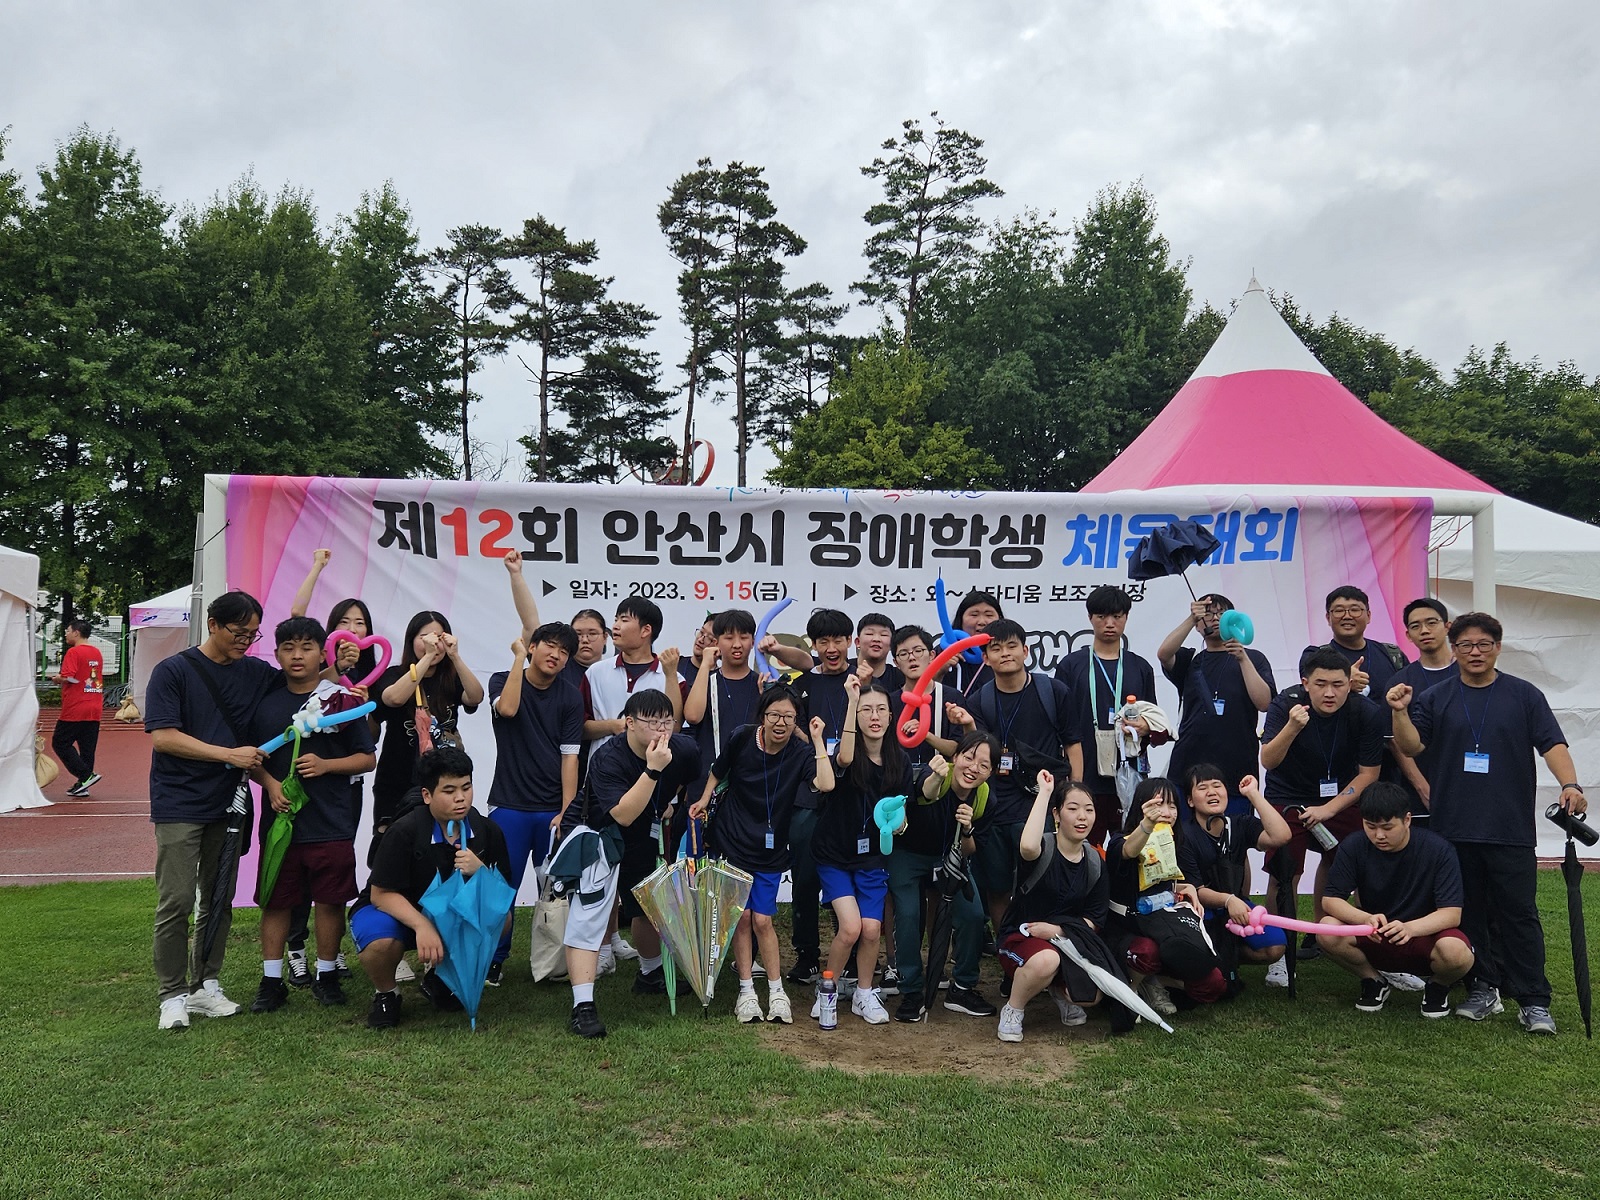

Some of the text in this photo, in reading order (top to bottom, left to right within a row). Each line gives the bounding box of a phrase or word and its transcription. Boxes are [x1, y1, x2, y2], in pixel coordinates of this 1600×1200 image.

[372, 499, 579, 564] 제12회
[602, 509, 785, 567] 안산시
[807, 511, 1047, 570] 장애학생
[569, 579, 788, 602] 일자: 2023. 9. 15(금)
[869, 584, 917, 604] 장소:
[1049, 583, 1146, 603] 보조장
